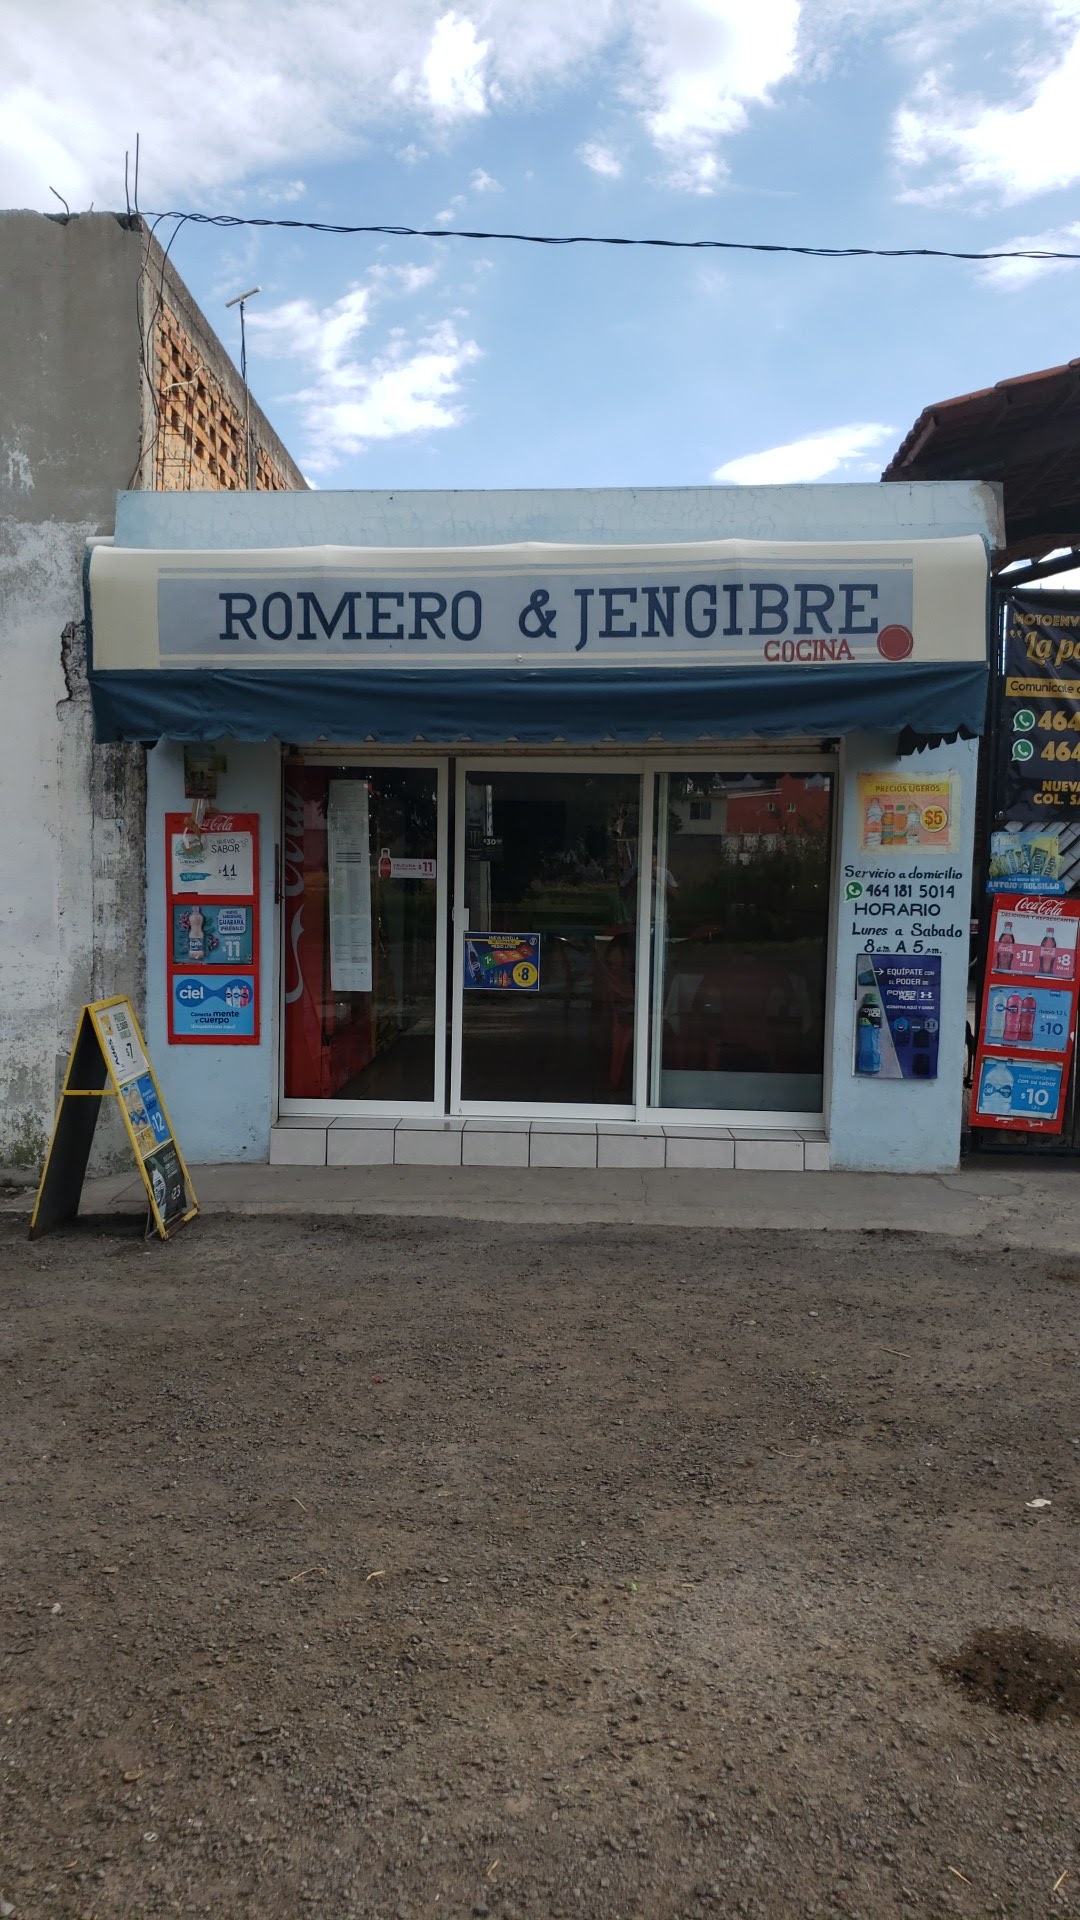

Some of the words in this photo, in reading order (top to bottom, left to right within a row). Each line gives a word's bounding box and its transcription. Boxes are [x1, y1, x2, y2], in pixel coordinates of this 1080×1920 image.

[219, 590, 482, 641] ROMERO
[518, 589, 557, 638] &
[574, 583, 879, 651] JENGIBRE
[1012, 612, 1080, 627] MOTOENV
[764, 638, 855, 662] COCINA
[875, 784, 907, 793] PRECIOS
[908, 784, 941, 792] LIGEROS
[1033, 793, 1064, 805] COL.
[924, 810, 943, 827] $5
[211, 843, 240, 853] SABOR
[844, 865, 895, 879] Servicio
[898, 871, 907, 879] a
[908, 866, 963, 880] domicilio
[866, 884, 890, 897] 464
[894, 884, 912, 897] 181
[919, 885, 955, 898] 5014
[1023, 882, 1060, 890] BOLSILLO
[854, 903, 941, 917] HORARIO
[852, 922, 888, 936] Lunes
[895, 928, 904, 936] a
[910, 923, 963, 938] Sabado
[222, 941, 241, 957] $11
[864, 938, 875, 953] 8
[895, 940, 907, 953] A
[912, 940, 924, 953] 5
[1016, 949, 1034, 963] $11
[1057, 954, 1071, 966] $8
[886, 968, 923, 976] EQUÍPATE
[180, 985, 204, 999] ciel
[1040, 1022, 1064, 1036] $10
[1020, 1088, 1049, 1106] $10
